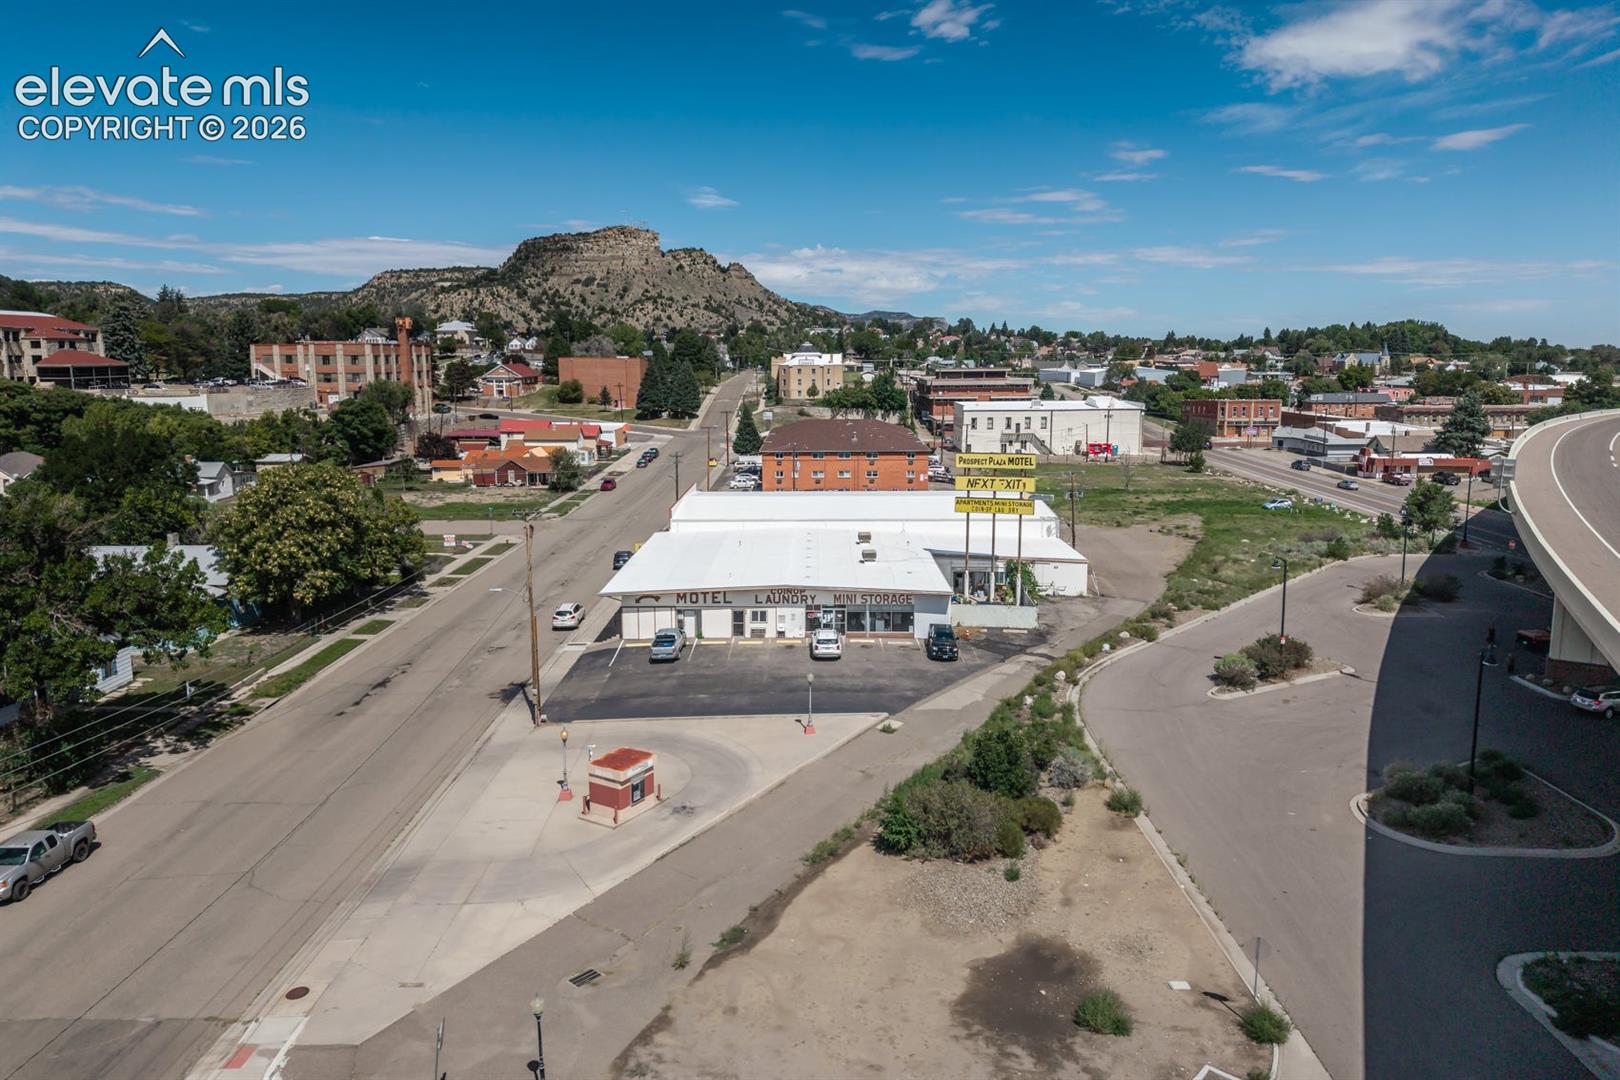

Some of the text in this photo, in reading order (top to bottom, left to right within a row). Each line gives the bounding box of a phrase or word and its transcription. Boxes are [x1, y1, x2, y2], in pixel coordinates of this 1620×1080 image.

[958, 456, 1034, 466] PROSPECT PLAZA MOTEL
[676, 591, 733, 604] MOTEL
[755, 594, 816, 604] LAUNDRY
[833, 594, 913, 604] MINI STORAGE
